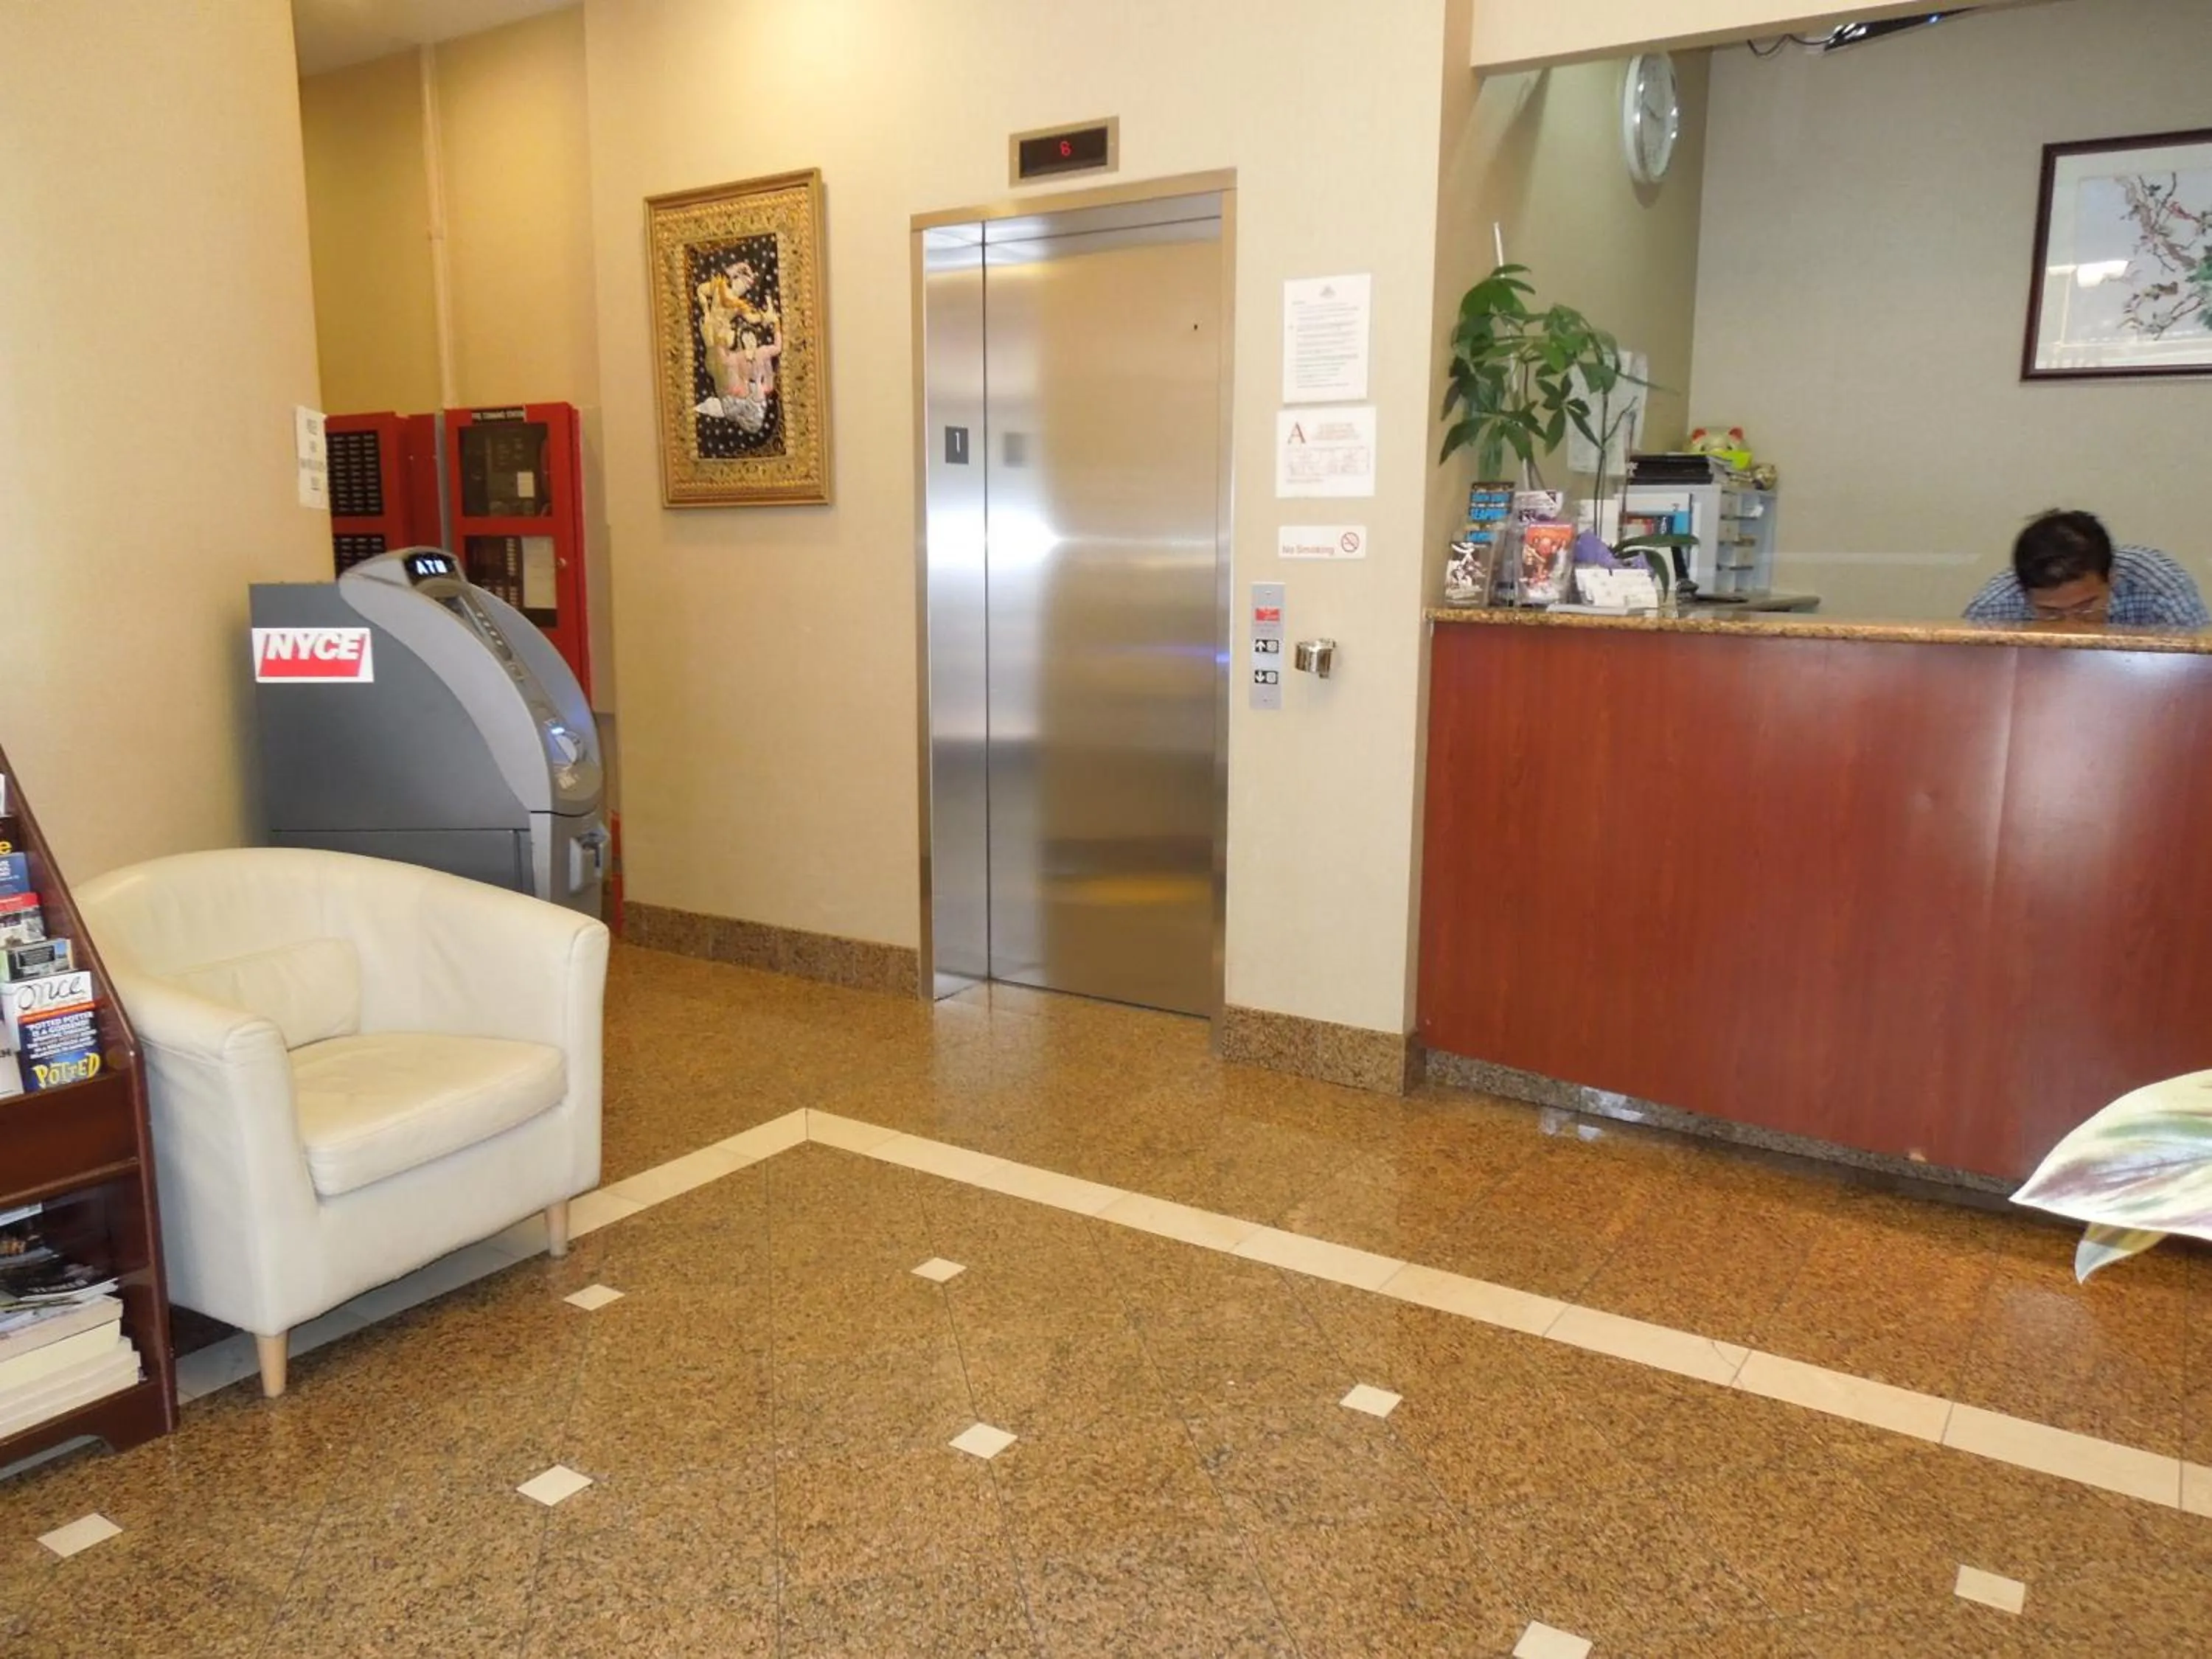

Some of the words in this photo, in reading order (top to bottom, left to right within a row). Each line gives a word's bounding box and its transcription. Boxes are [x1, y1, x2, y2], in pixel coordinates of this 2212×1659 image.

[1060, 140, 1071, 156] 6
[955, 431, 961, 453] 1
[1287, 421, 1307, 445] A
[1296, 544, 1335, 557] Smoking
[415, 558, 448, 574] ATM
[265, 633, 363, 661] NYCE
